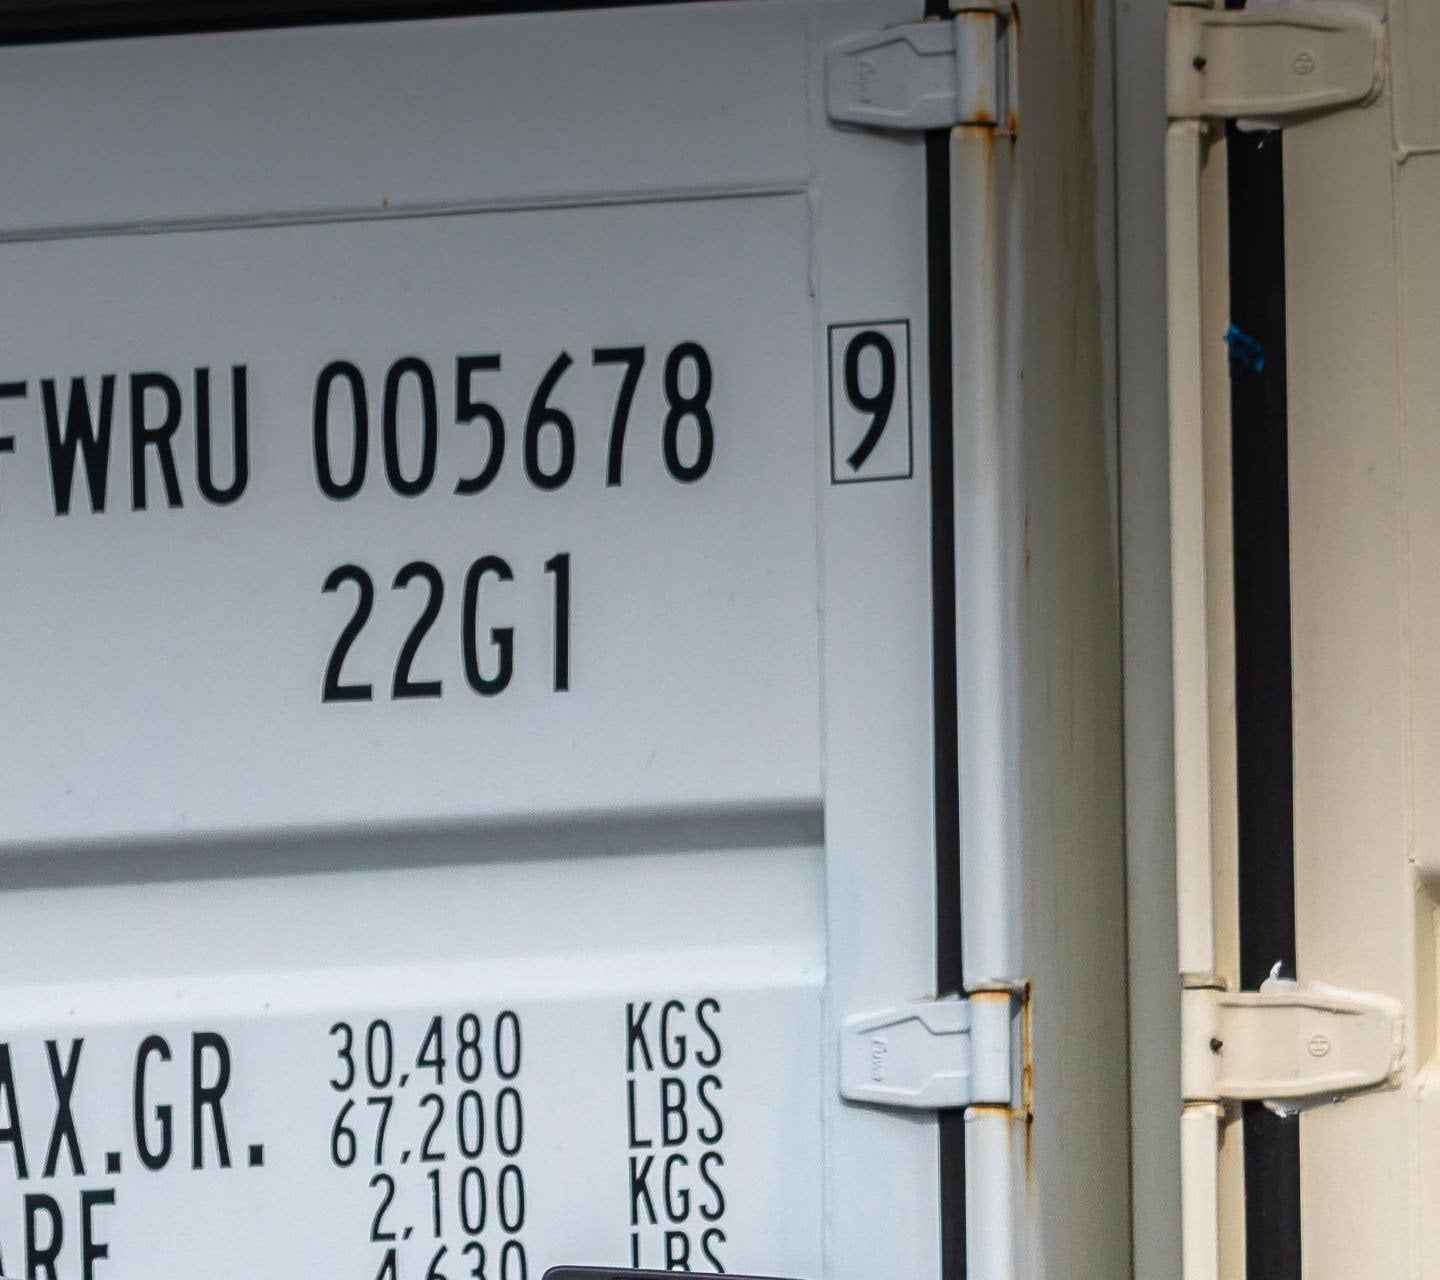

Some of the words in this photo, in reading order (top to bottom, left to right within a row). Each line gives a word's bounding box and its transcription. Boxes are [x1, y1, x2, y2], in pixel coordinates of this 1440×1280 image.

[313, 341, 714, 501] 005678
[844, 330, 896, 472] 9
[321, 552, 571, 704] 22G1
[329, 1010, 522, 1093] 30,480
[626, 997, 722, 1073] KGS
[331, 1084, 523, 1171] 67,200
[627, 1074, 724, 1149] LBS
[369, 1163, 525, 1248] 2,100
[629, 1150, 726, 1226] KGS
